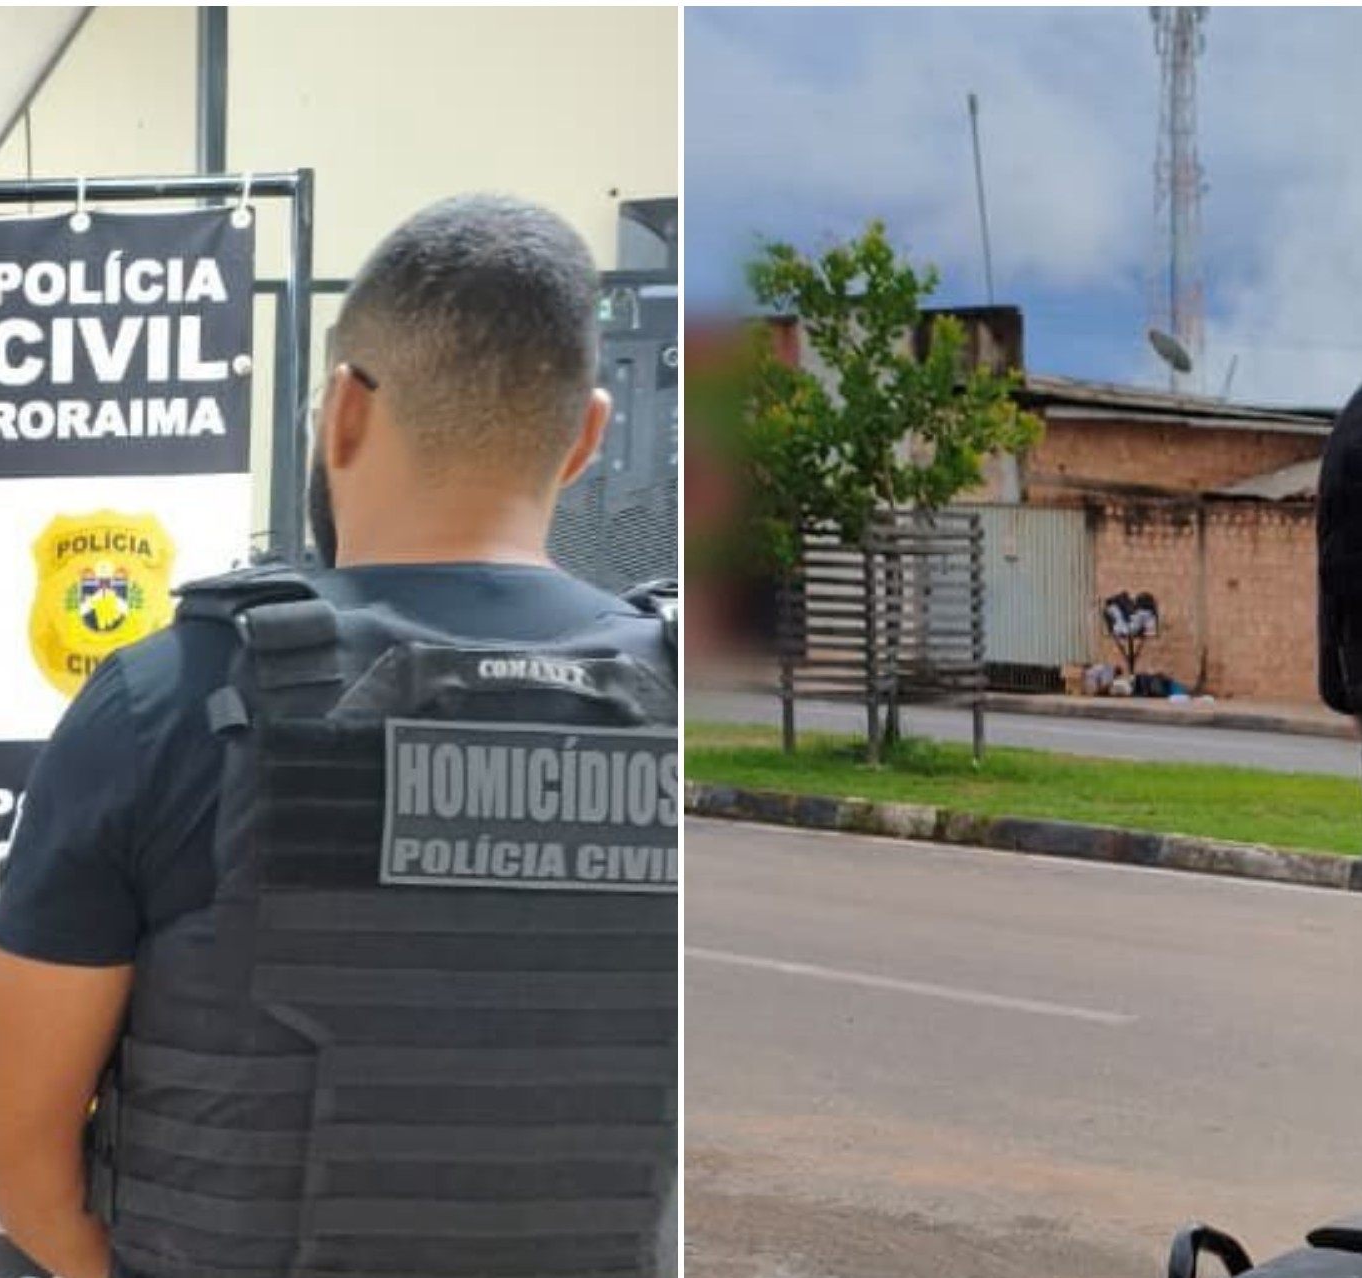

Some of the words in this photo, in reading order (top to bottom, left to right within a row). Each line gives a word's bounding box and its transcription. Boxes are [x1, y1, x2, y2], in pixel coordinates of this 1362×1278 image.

[56, 529, 154, 560] POLÍCIA
[396, 735, 678, 827] HOMICÍDIOS
[391, 833, 567, 878] POLÍCIA
